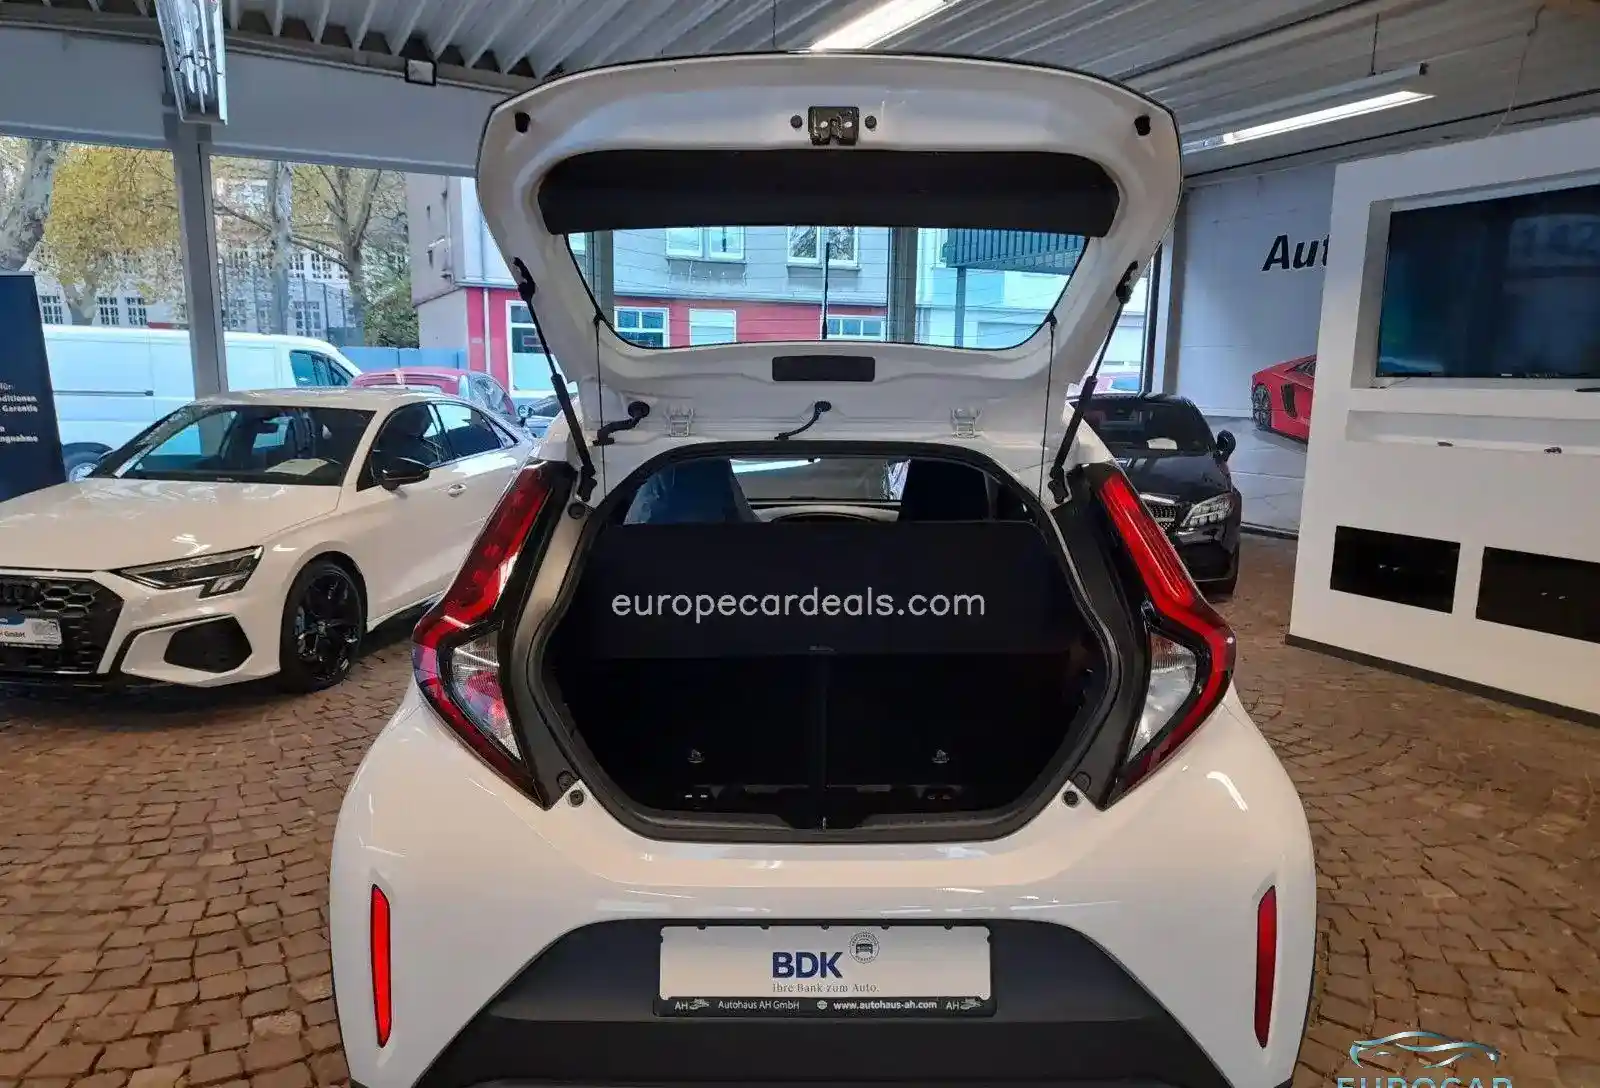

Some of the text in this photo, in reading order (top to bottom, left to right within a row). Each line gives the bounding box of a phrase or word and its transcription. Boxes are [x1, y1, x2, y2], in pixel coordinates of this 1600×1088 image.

[2, 404, 38, 412] Garantie
[772, 951, 843, 978] BDK
[772, 983, 794, 993] Ihre
[797, 983, 822, 993] Bank
[825, 985, 848, 993] zum
[674, 1001, 688, 1010] AH
[718, 1000, 800, 1010] Autohaus AH GmbH
[833, 1000, 937, 1010] www.autohaus-ah.com
[946, 1001, 960, 1010] AH
